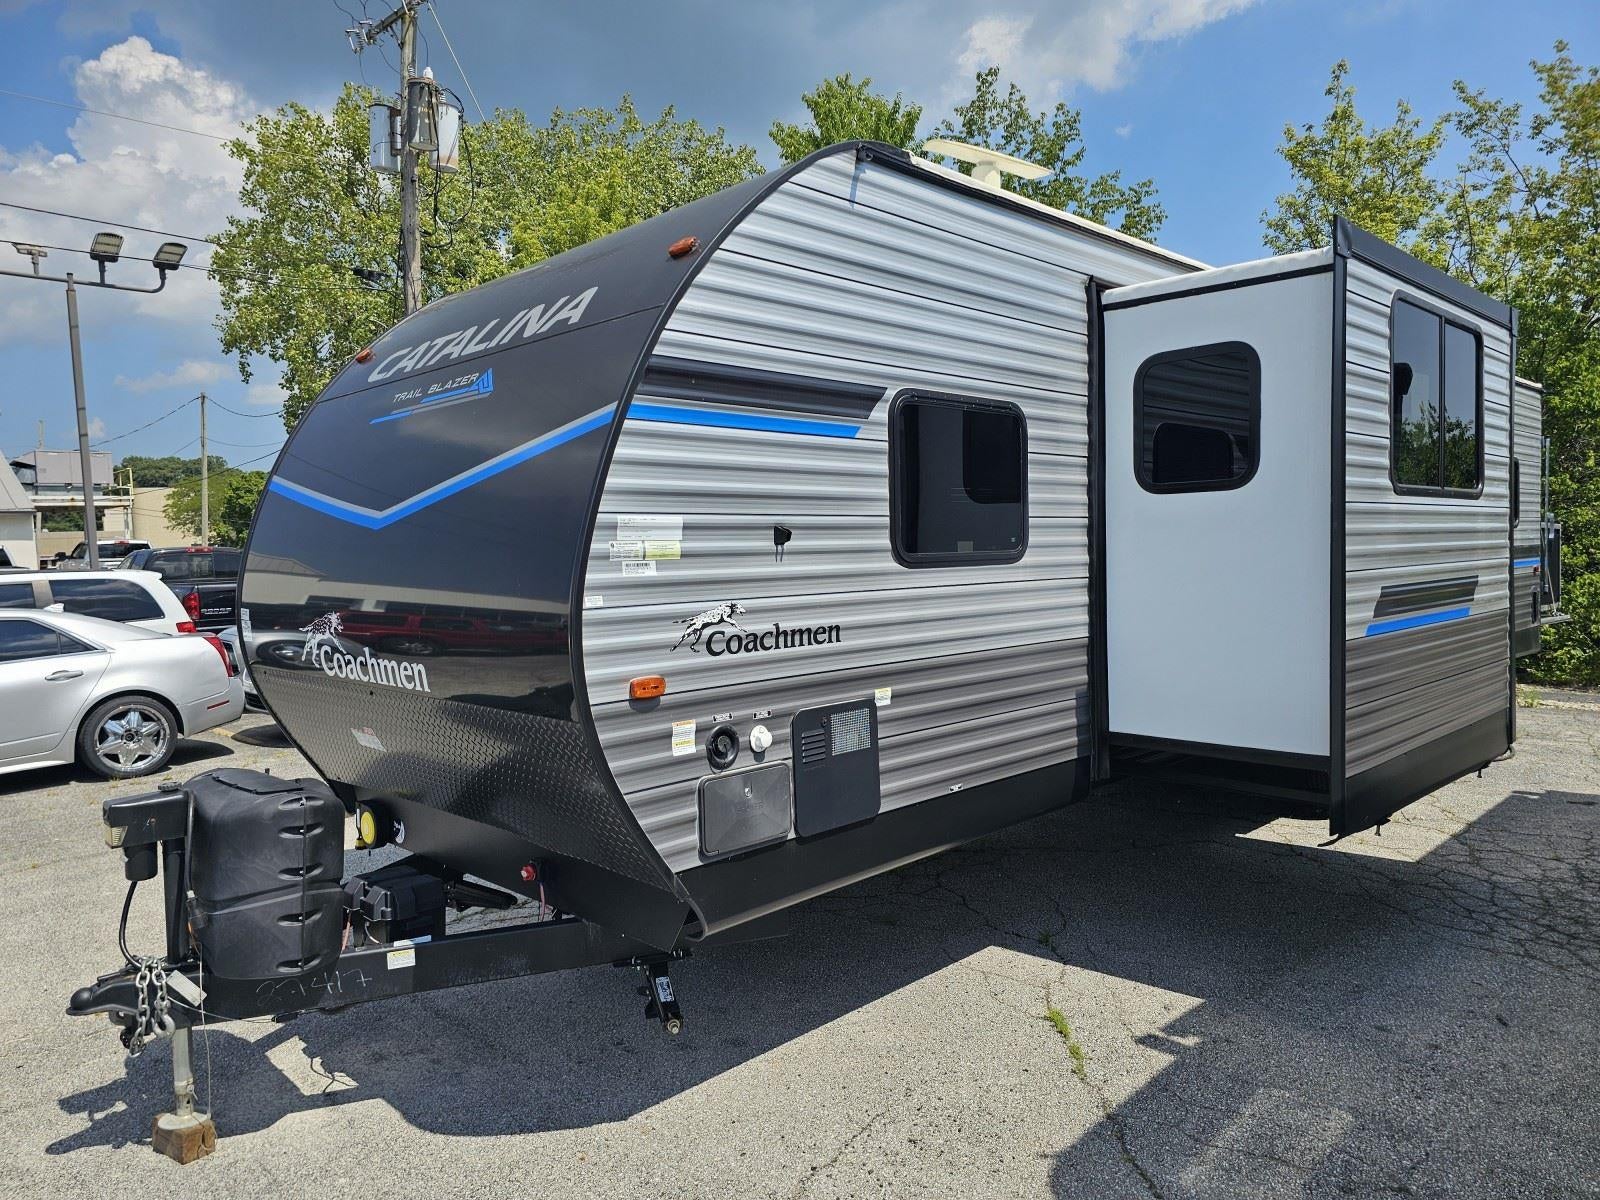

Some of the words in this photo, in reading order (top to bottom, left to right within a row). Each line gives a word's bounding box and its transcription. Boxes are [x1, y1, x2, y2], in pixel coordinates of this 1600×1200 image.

[367, 286, 599, 383] CATALINA
[393, 387, 422, 402] TRAIL
[427, 372, 480, 394] BLAZER
[705, 622, 842, 657] Coachmen
[320, 644, 431, 693] Coachmen
